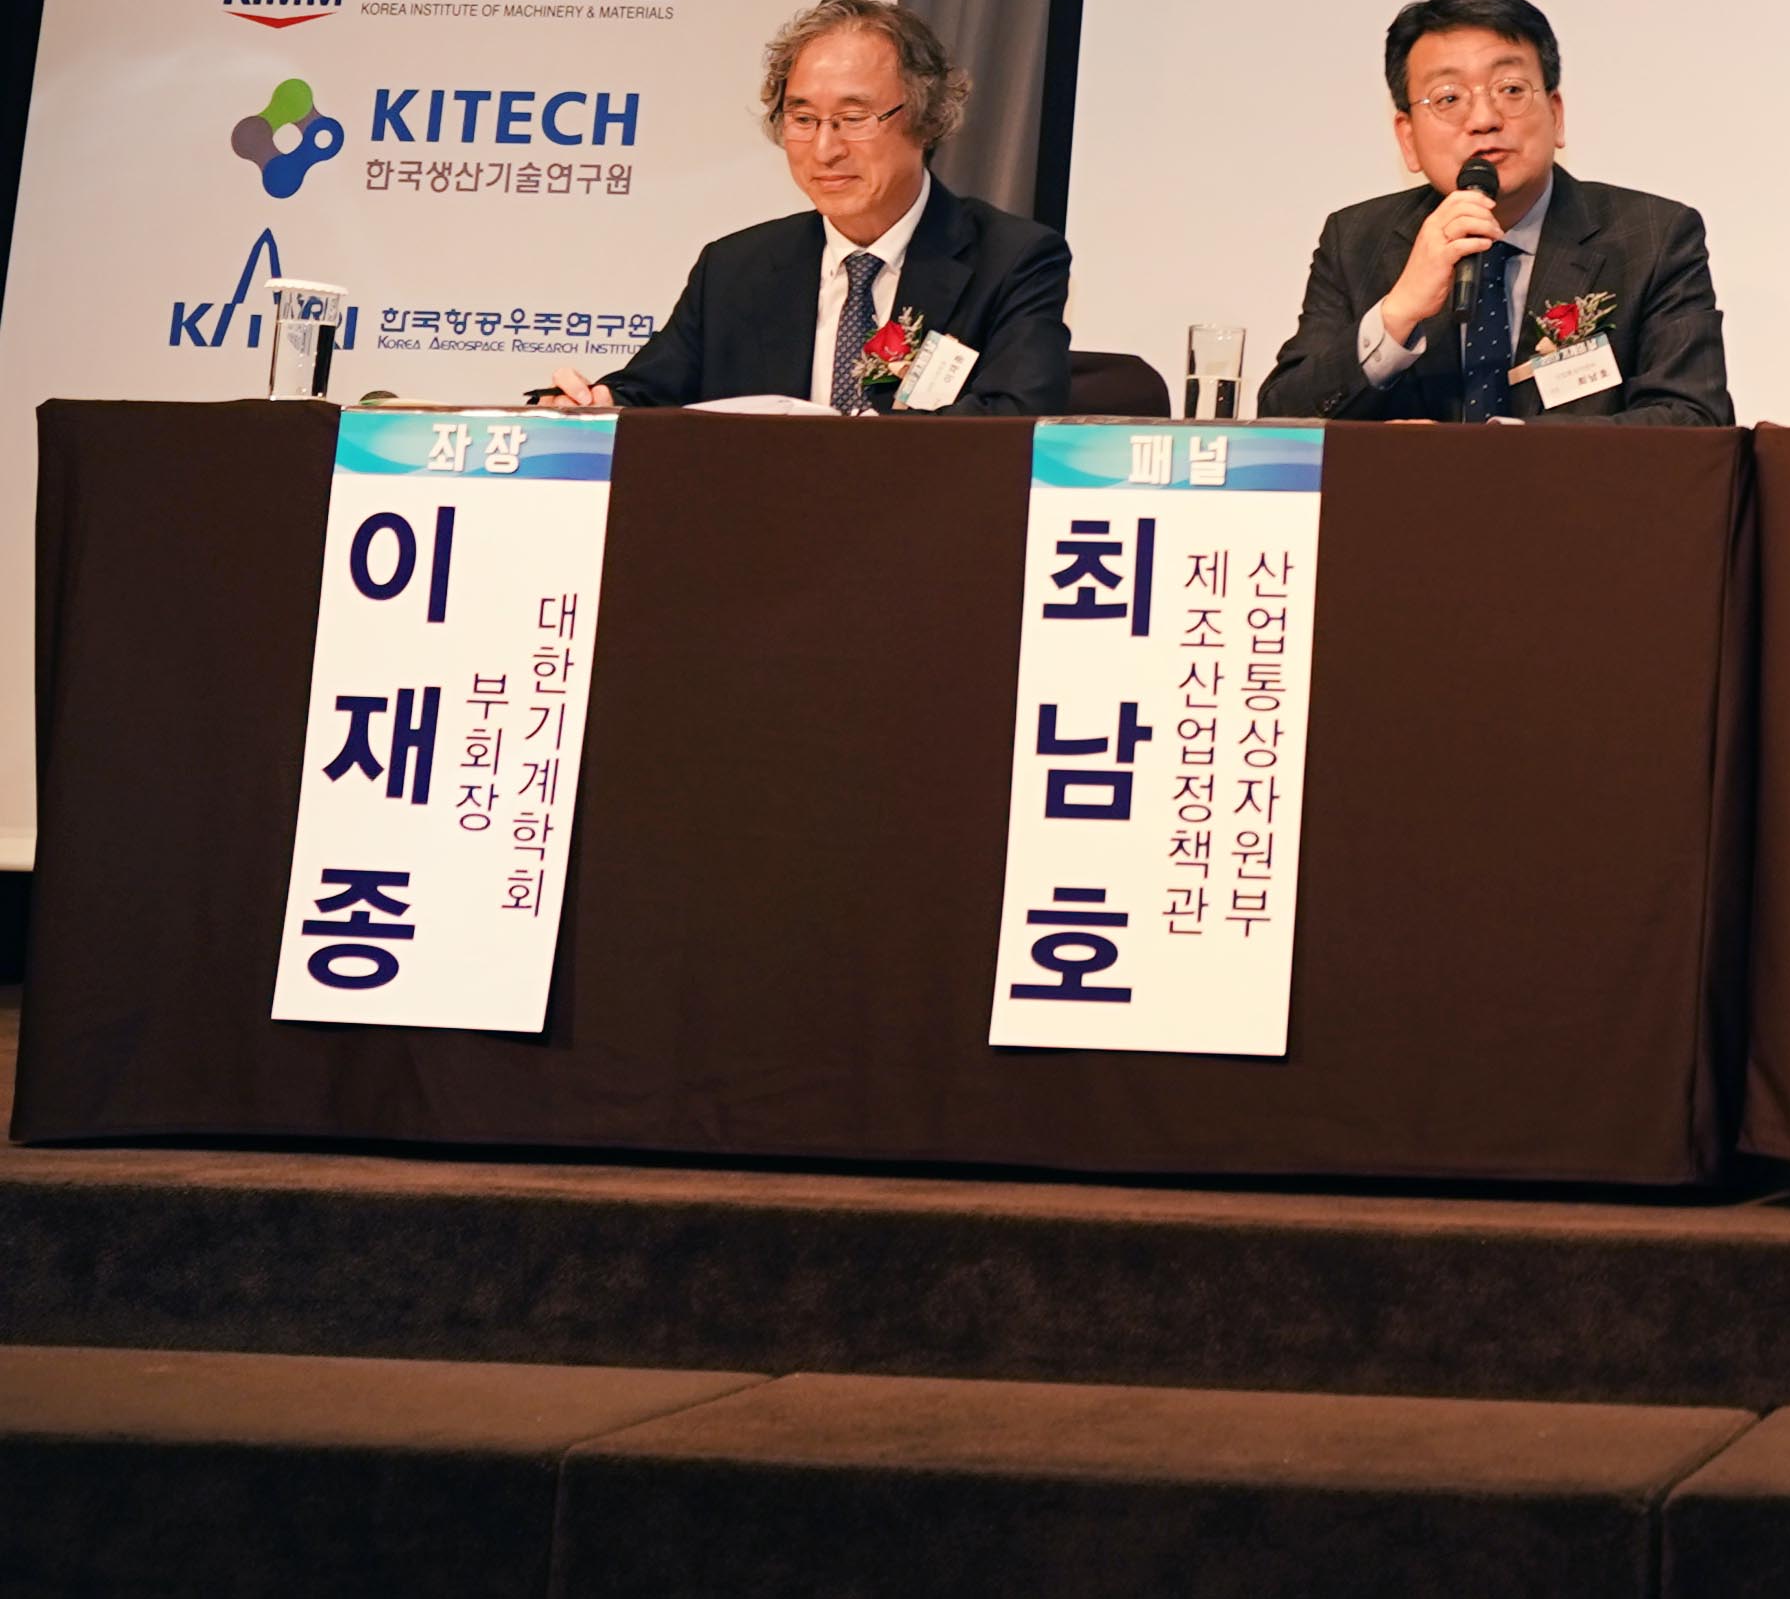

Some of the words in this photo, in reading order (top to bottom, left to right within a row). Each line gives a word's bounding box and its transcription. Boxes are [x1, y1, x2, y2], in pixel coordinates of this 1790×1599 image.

[360, 2, 407, 16] KOREA
[410, 2, 478, 17] INSTITUTE
[482, 3, 500, 17] OF
[503, 4, 584, 18] MACHINERY
[586, 5, 595, 18] &
[598, 5, 674, 20] MATERIALS
[370, 88, 639, 146] KITECH
[365, 157, 633, 195] 한국생산기술연구원
[381, 308, 653, 338] 한국항공우주연구원
[428, 422, 528, 474] 좌장
[1128, 434, 1230, 487] 패널
[454, 672, 510, 833] 부회장
[501, 592, 578, 918] 대한기계학회
[1162, 550, 1230, 936] 제조산업정책관
[1224, 550, 1296, 938] 산업통상자원부
